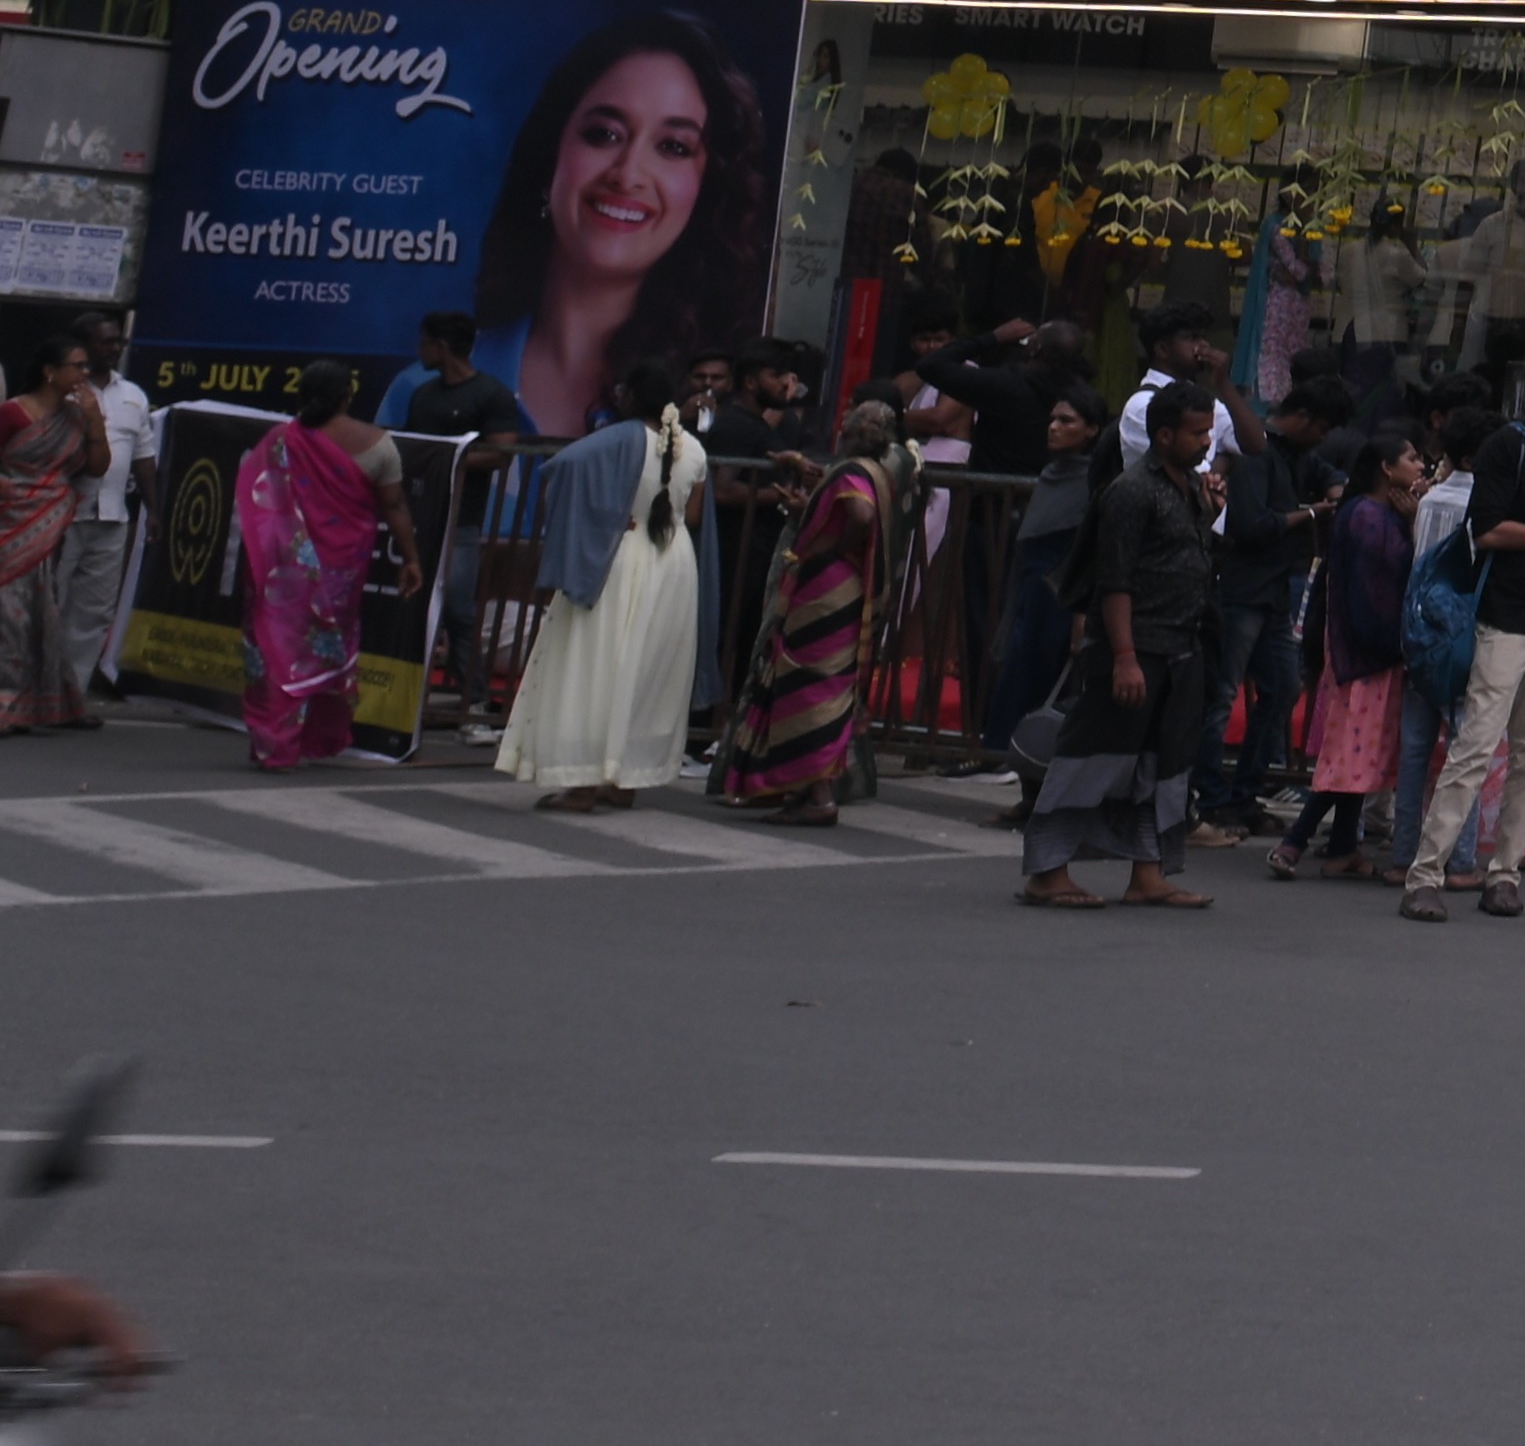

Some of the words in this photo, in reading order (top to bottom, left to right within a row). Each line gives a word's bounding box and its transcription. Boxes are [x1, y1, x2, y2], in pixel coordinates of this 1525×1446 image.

[287, 8, 382, 35] GRAND
[954, 4, 1041, 31] SMART
[1049, 9, 1145, 37] WATCH
[193, 1, 474, 118] Opening
[234, 167, 348, 193] CELEBRITY
[352, 171, 423, 195] GUEST
[182, 209, 318, 258] Keerthi
[329, 214, 458, 262] Suresh
[254, 281, 351, 303] ACTRESS
[200, 364, 270, 392] JULY
